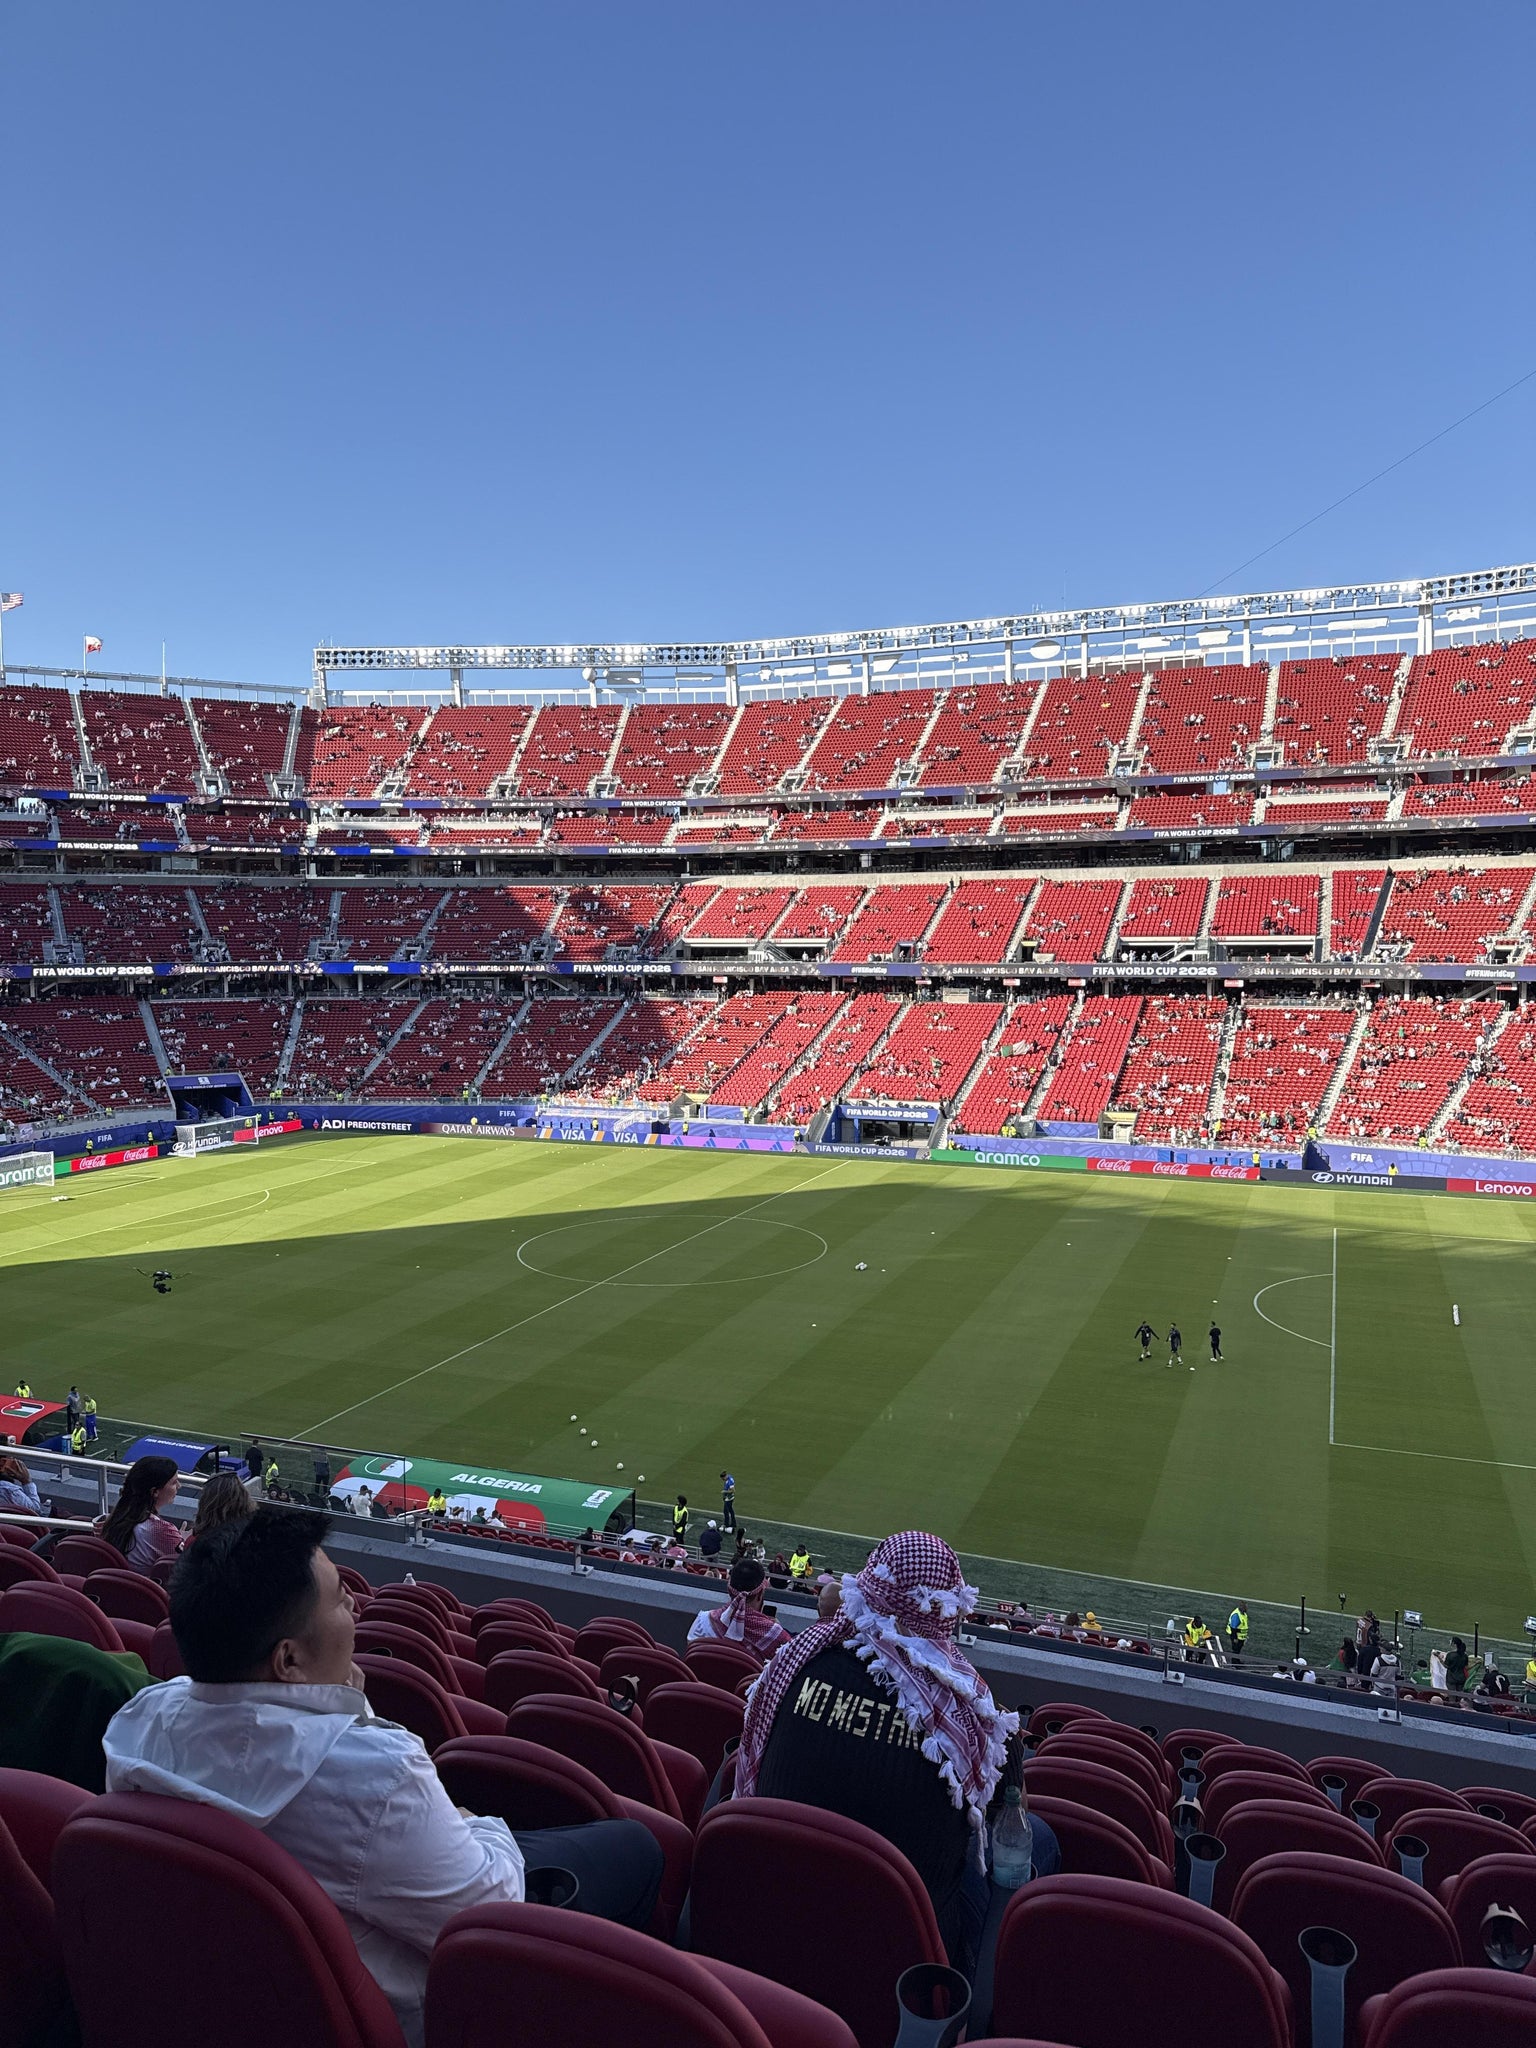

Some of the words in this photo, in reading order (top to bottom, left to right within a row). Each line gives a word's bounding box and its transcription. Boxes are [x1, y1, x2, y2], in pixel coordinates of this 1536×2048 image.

[1173, 776, 1188, 784] FIFA
[1189, 775, 1214, 783] WORLD
[1215, 774, 1230, 782] CUP
[69, 792, 82, 800] FIFA
[84, 792, 108, 800] WORLD
[1213, 828, 1239, 836] 2026
[73, 842, 98, 850] WORLD
[99, 842, 113, 850] CUP
[33, 968, 55, 976] FIFA
[57, 967, 94, 976] WORLD
[96, 967, 116, 976] CUP
[117, 966, 153, 974] 2026
[573, 964, 592, 972] FIFA
[626, 965, 642, 973] CUP
[643, 965, 672, 973] 2026
[1092, 966, 1115, 976] FIFA
[1116, 966, 1154, 976] WORLD
[1156, 966, 1177, 976] CUP
[1178, 966, 1218, 976] 2026
[1254, 968, 1274, 976] SAN
[1333, 968, 1352, 976] BAY
[1466, 969, 1516, 979] #FIFAWorldCup
[846, 1108, 862, 1116] FIFA
[862, 1109, 887, 1117] WORLD
[888, 1110, 902, 1118] CUP
[322, 1120, 346, 1129] ADI
[347, 1120, 412, 1131] PREDICTSTREET
[442, 1124, 472, 1134] QATAR
[476, 1125, 515, 1136] AIRWAYS
[98, 1133, 112, 1143] FIFA
[254, 1126, 284, 1138] Lenovo
[560, 1129, 586, 1141] VISA
[612, 1132, 638, 1144] VISA
[187, 1136, 220, 1149] HYUNDAI
[124, 1147, 150, 1162] Coca-Cola
[815, 1144, 832, 1152] FIFA
[832, 1145, 861, 1154] WORLD
[862, 1146, 877, 1154] CUP
[878, 1148, 904, 1156] 2026
[80, 1154, 108, 1170] Coca-Cola
[974, 1152, 1040, 1166] aramco
[1350, 1153, 1374, 1163] FIFA
[1096, 1159, 1132, 1172] Coca-Cola
[1153, 1162, 1190, 1176] Coca-Cola
[1210, 1166, 1250, 1180] Coca-Cola
[1336, 1174, 1393, 1186] HYUNDAI
[1475, 1180, 1532, 1196] Lenovo
[450, 1473, 543, 1494] ALGERIA
